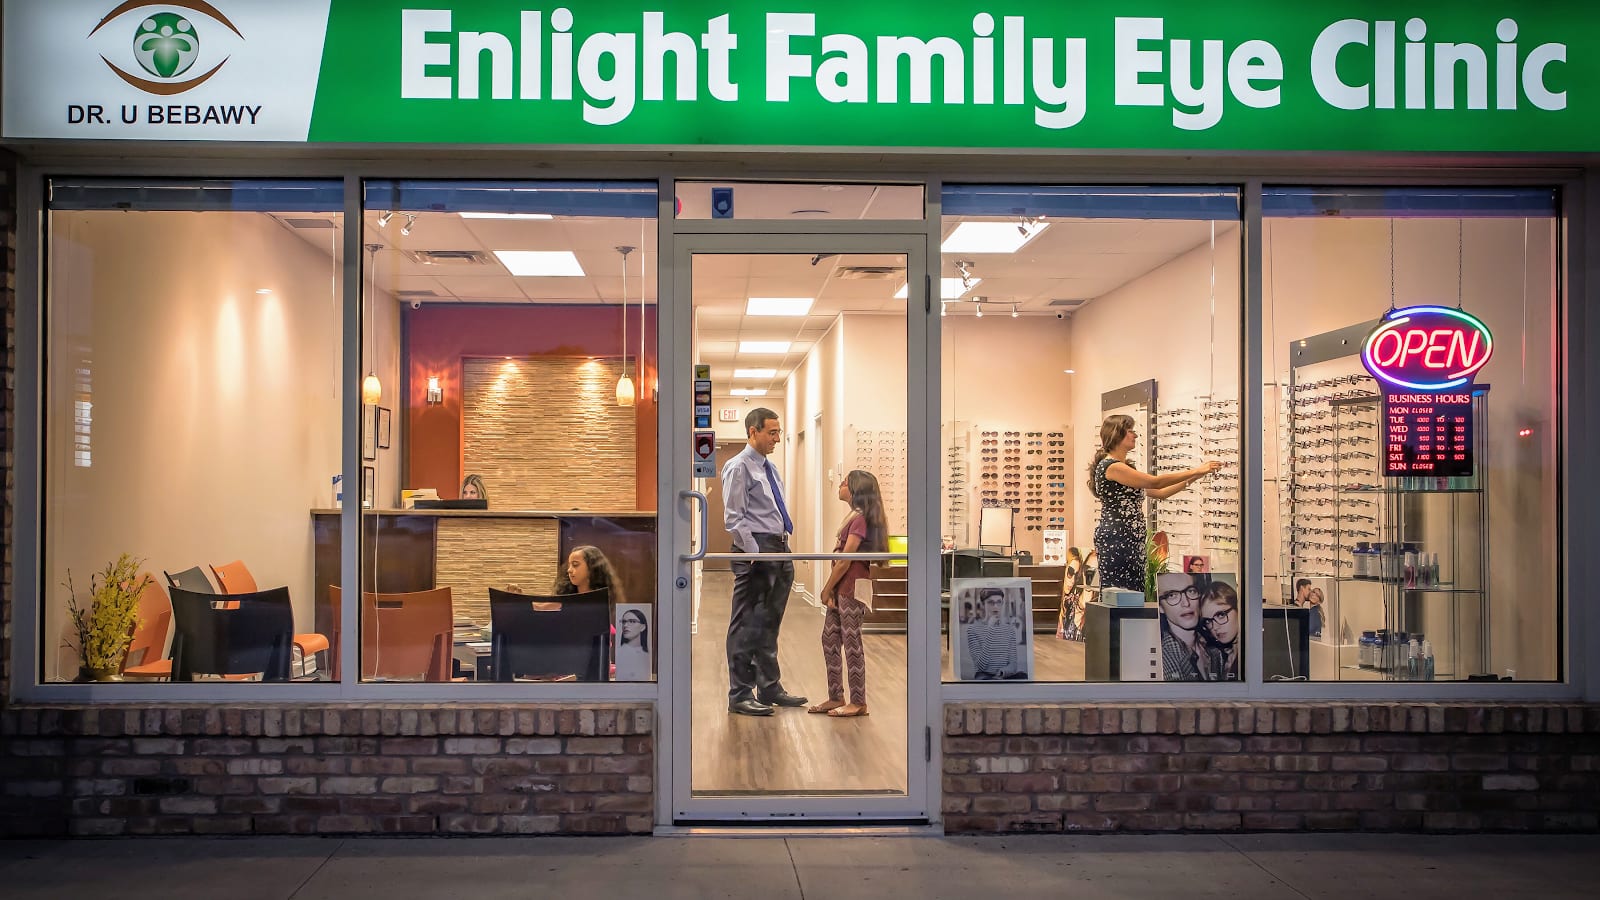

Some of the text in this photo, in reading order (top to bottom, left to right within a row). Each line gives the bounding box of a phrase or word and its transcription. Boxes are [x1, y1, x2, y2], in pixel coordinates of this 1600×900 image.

[401, 7, 1567, 131] Enlight Family Eye Clinic
[67, 104, 262, 125] DR. U BEBAWY
[1373, 329, 1481, 368] OPEN
[1388, 394, 1470, 404] BUSINESS HOURS
[723, 409, 737, 420] EXIT
[1389, 406, 1409, 415] MON
[1389, 416, 1405, 424] TUE
[1389, 425, 1409, 433] WED
[1389, 434, 1407, 442] THU
[1389, 443, 1402, 452] FRI
[1389, 453, 1404, 461] SAT
[702, 466, 713, 474] Pay
[1389, 462, 1407, 470] SUN
